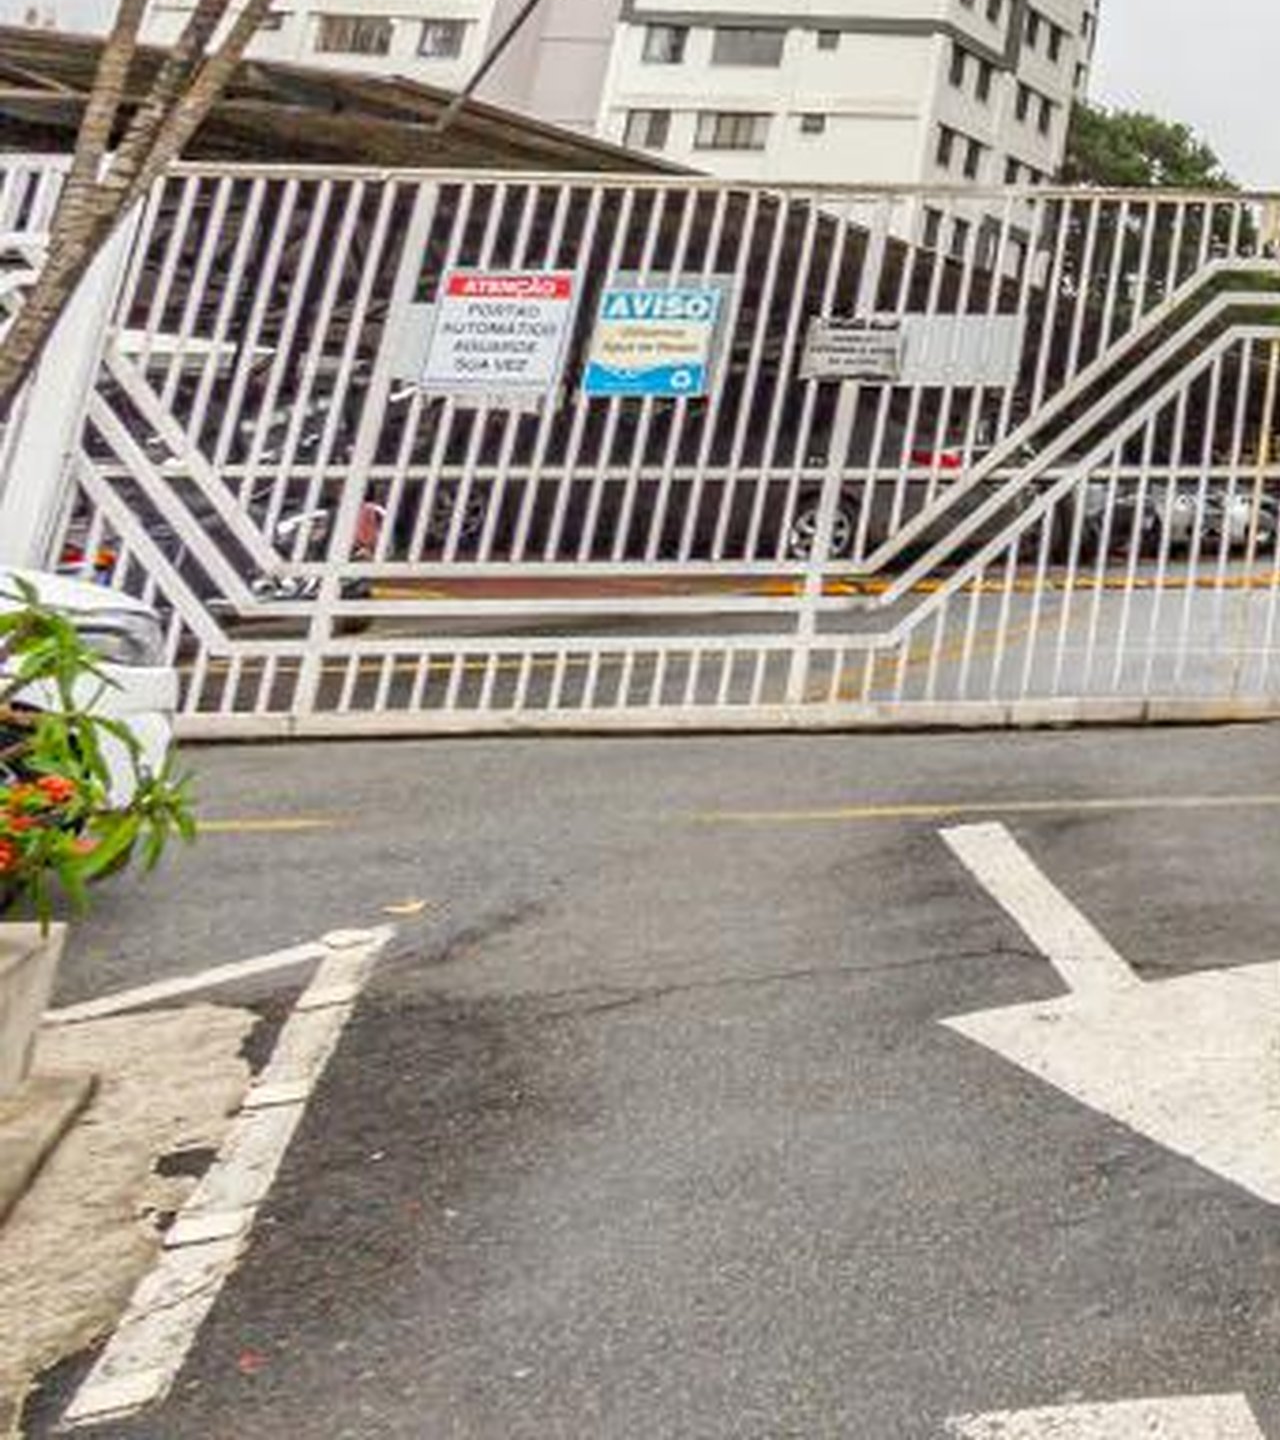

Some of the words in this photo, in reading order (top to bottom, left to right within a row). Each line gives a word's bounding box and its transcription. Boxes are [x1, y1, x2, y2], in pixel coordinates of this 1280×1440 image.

[462, 276, 557, 297] ATENÇÃO
[608, 295, 709, 318] AVISO
[454, 357, 492, 373] SUA
[495, 357, 530, 373] VEZ
